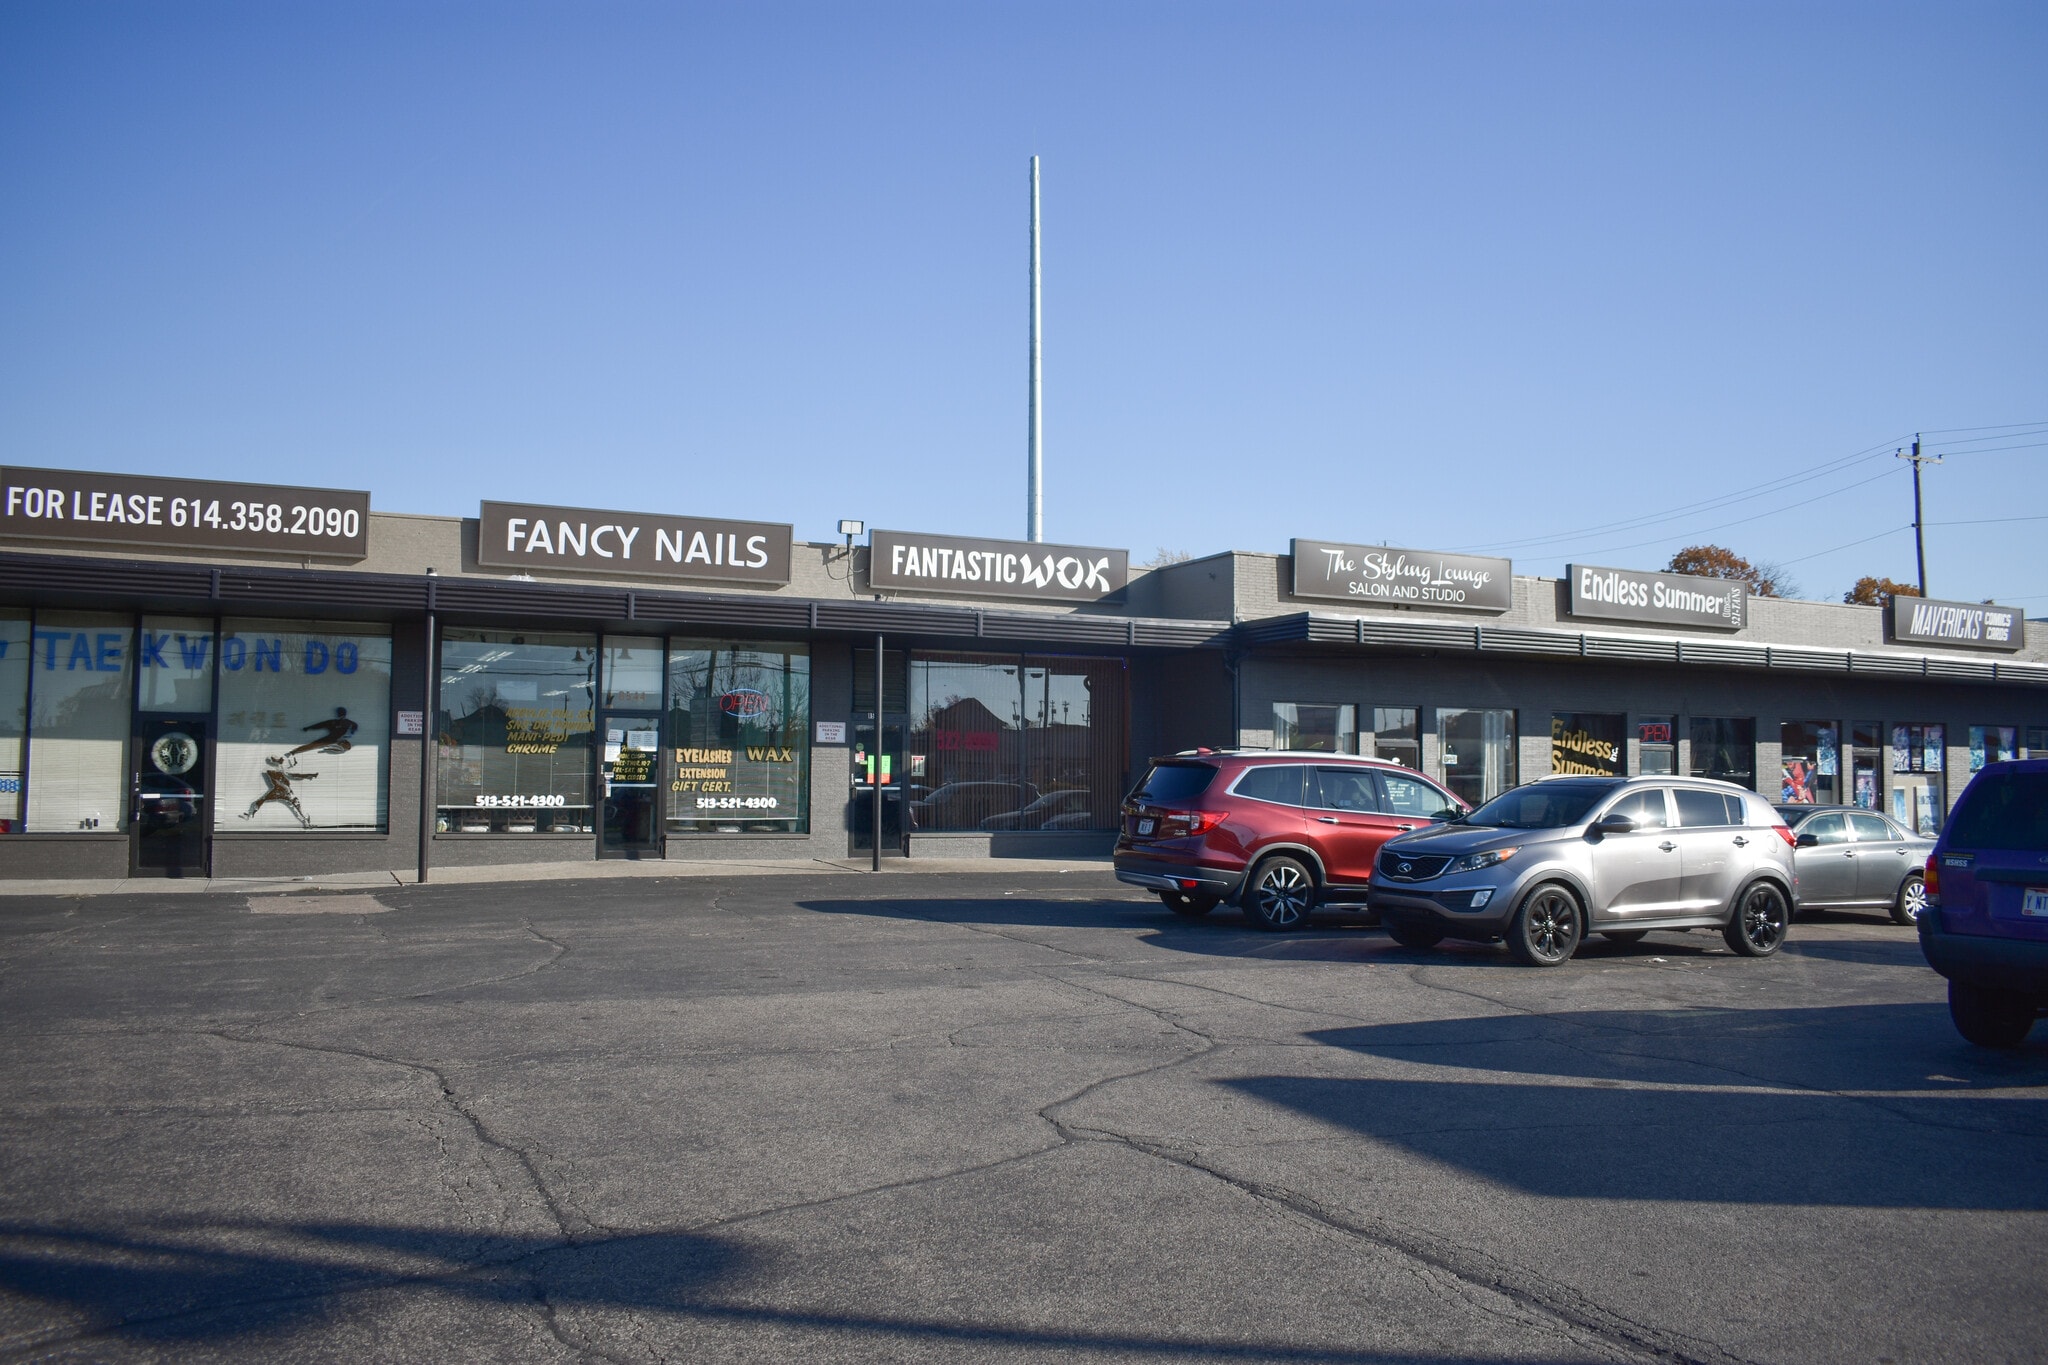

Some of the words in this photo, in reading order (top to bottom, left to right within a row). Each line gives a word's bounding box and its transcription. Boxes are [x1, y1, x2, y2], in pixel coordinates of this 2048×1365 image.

[6, 486, 65, 519] FOR
[74, 491, 164, 525] LEASE
[170, 497, 360, 538] 614.358.2090
[507, 518, 640, 559] FANCY
[655, 528, 768, 569] NAILS
[892, 545, 1016, 583] FANTASTIC
[1019, 553, 1110, 592] WOK
[1320, 548, 1356, 581] The
[1363, 553, 1431, 585] Styling
[1431, 561, 1492, 589] Lounge
[1349, 582, 1389, 597] SALON
[1392, 586, 1419, 599] AND
[1422, 587, 1466, 602] STUDIO
[1580, 568, 1648, 607] Endless
[1653, 581, 1723, 614] Summer
[1910, 604, 1983, 639] MAVERICKS
[1984, 612, 2012, 627] COMICS
[34, 631, 122, 671] TAE
[304, 640, 358, 675] DO
[720, 693, 769, 711] OPEN
[506, 719, 530, 731] SNS
[533, 720, 552, 731] DIP
[507, 743, 559, 755] CHROME
[1552, 719, 1612, 759] Endless
[676, 748, 732, 763] EYELASHES
[746, 747, 792, 762] WAX
[680, 768, 727, 779] EXTENSION
[671, 781, 698, 791] GIFT
[701, 781, 731, 792] CERT.
[475, 794, 565, 807] 513-521-4300
[696, 797, 777, 809] 513-521-4300
